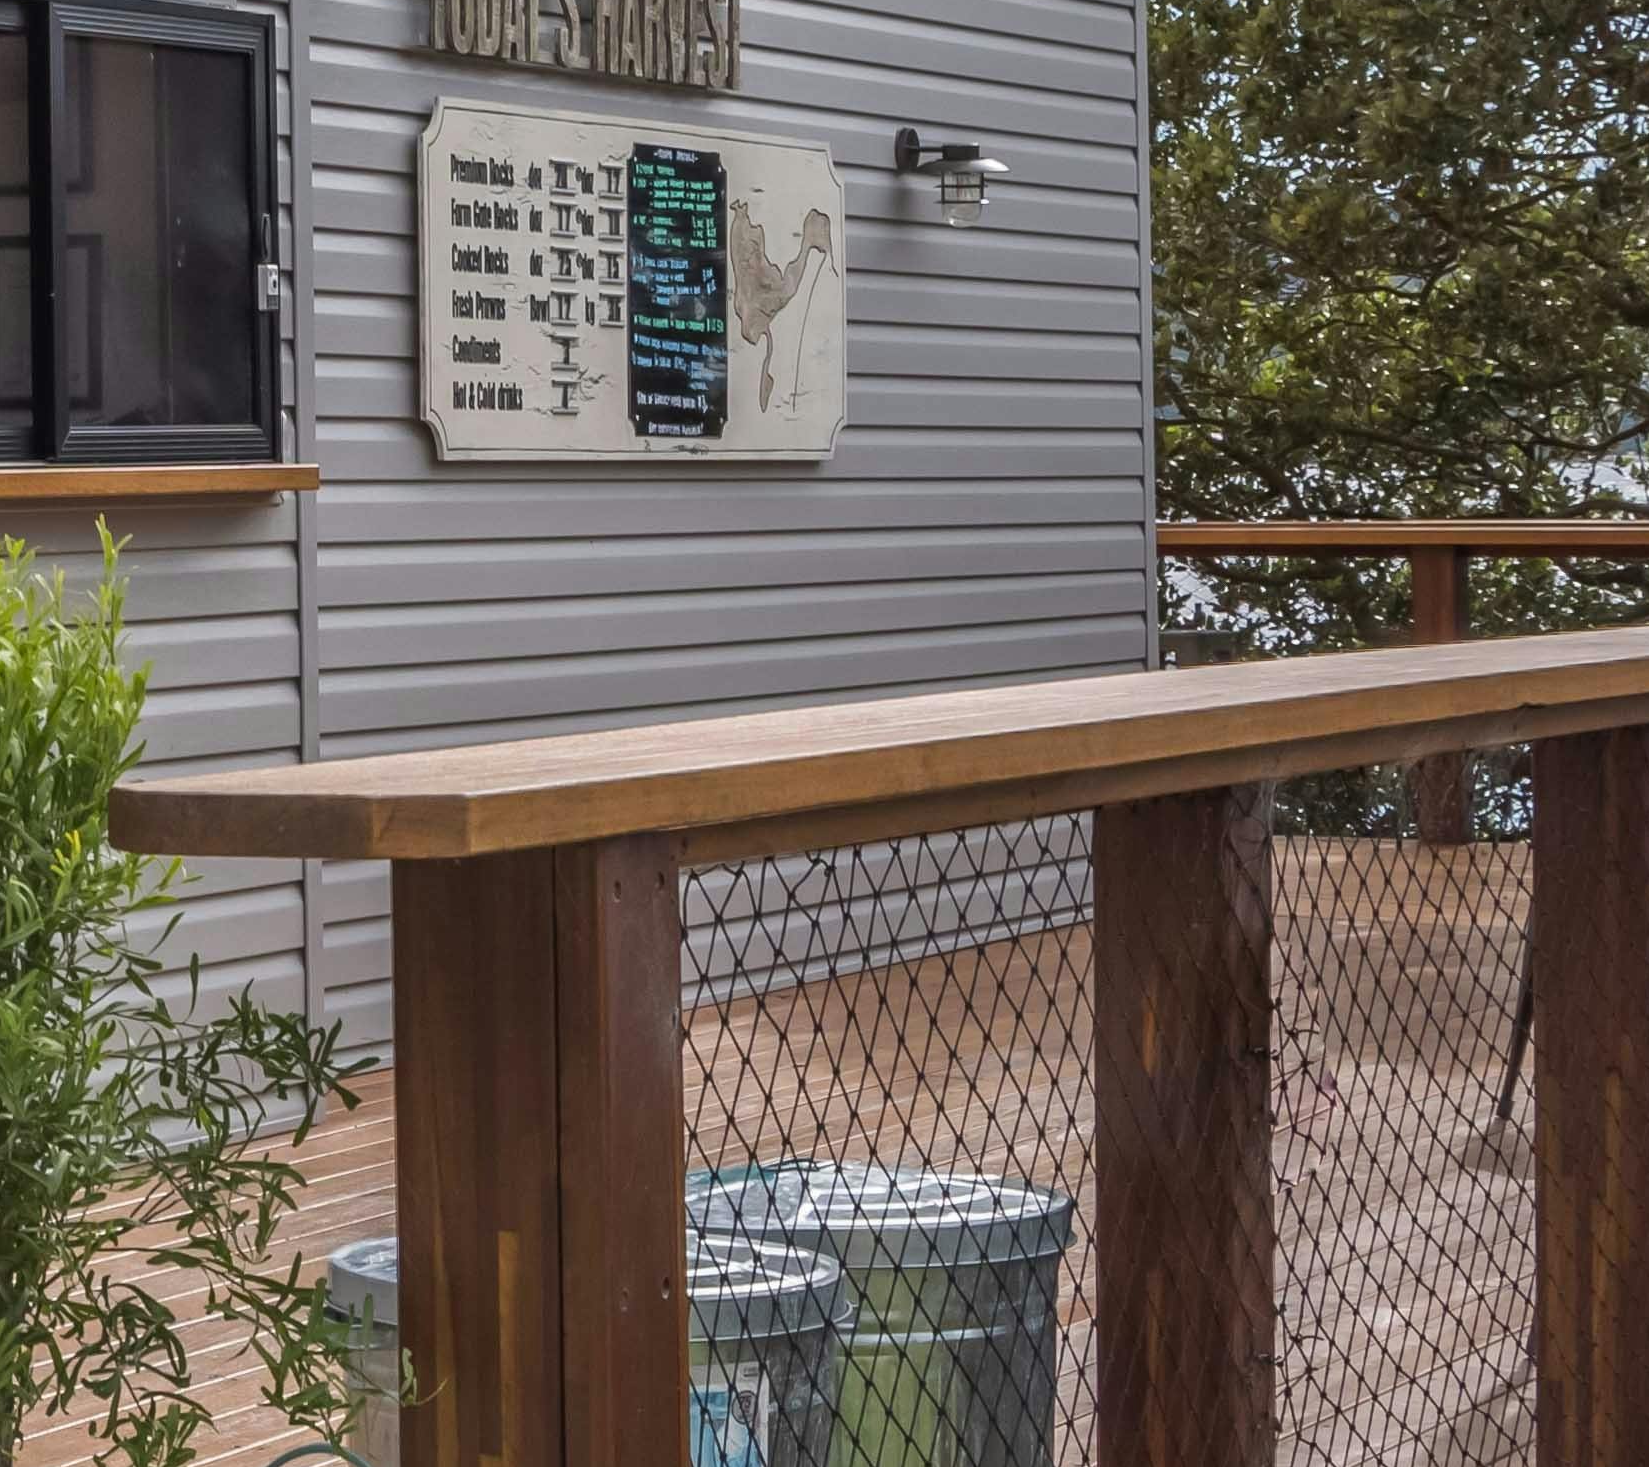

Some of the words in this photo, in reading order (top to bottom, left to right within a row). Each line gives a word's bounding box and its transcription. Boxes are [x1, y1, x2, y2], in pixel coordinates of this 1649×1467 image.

[450, 153, 488, 185] Premium
[489, 157, 515, 187] Rocks
[451, 197, 472, 228] Farm
[473, 199, 493, 229] Gate
[494, 200, 519, 231] Rocks
[451, 242, 483, 272] Cooked
[484, 245, 510, 275] Rocks
[452, 290, 474, 319] Fresh
[475, 290, 506, 321] Prawns
[530, 294, 551, 322] Bowl
[452, 381, 467, 410] Hot
[469, 381, 476, 410] &
[477, 381, 496, 411] Cold
[498, 382, 524, 411] drinks
